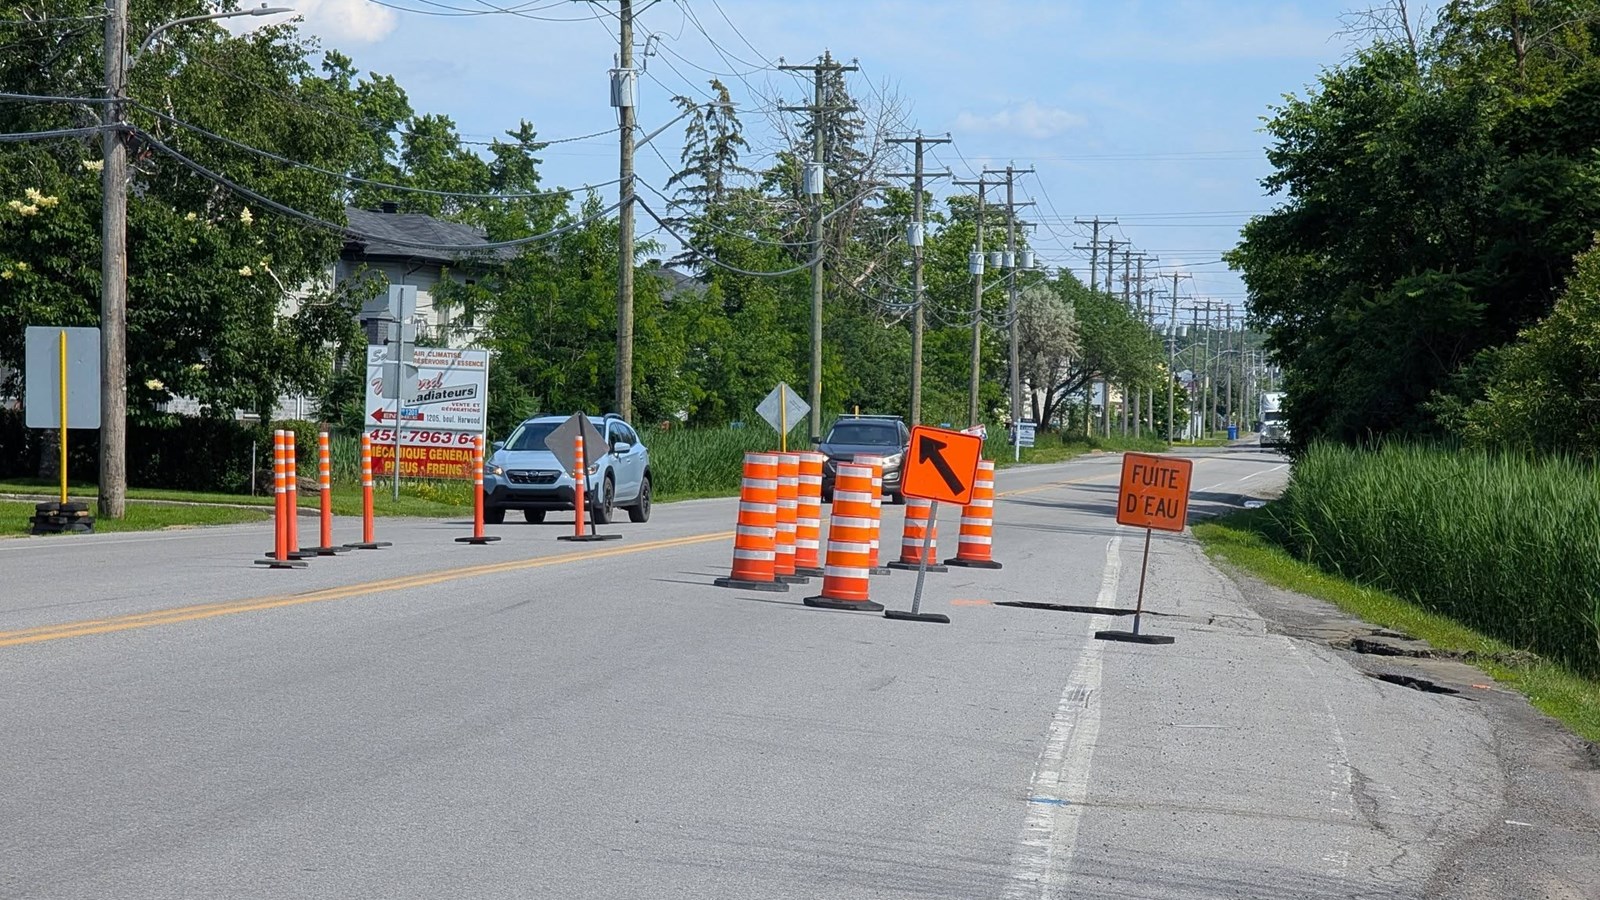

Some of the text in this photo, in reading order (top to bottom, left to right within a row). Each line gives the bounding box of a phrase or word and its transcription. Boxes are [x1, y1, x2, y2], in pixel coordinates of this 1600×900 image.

[407, 387, 474, 403] adiateurs
[458, 416, 480, 424] Harwood
[427, 462, 462, 475] FREINS
[1132, 465, 1180, 489] FUITE
[1126, 493, 1179, 519] D'EAU
